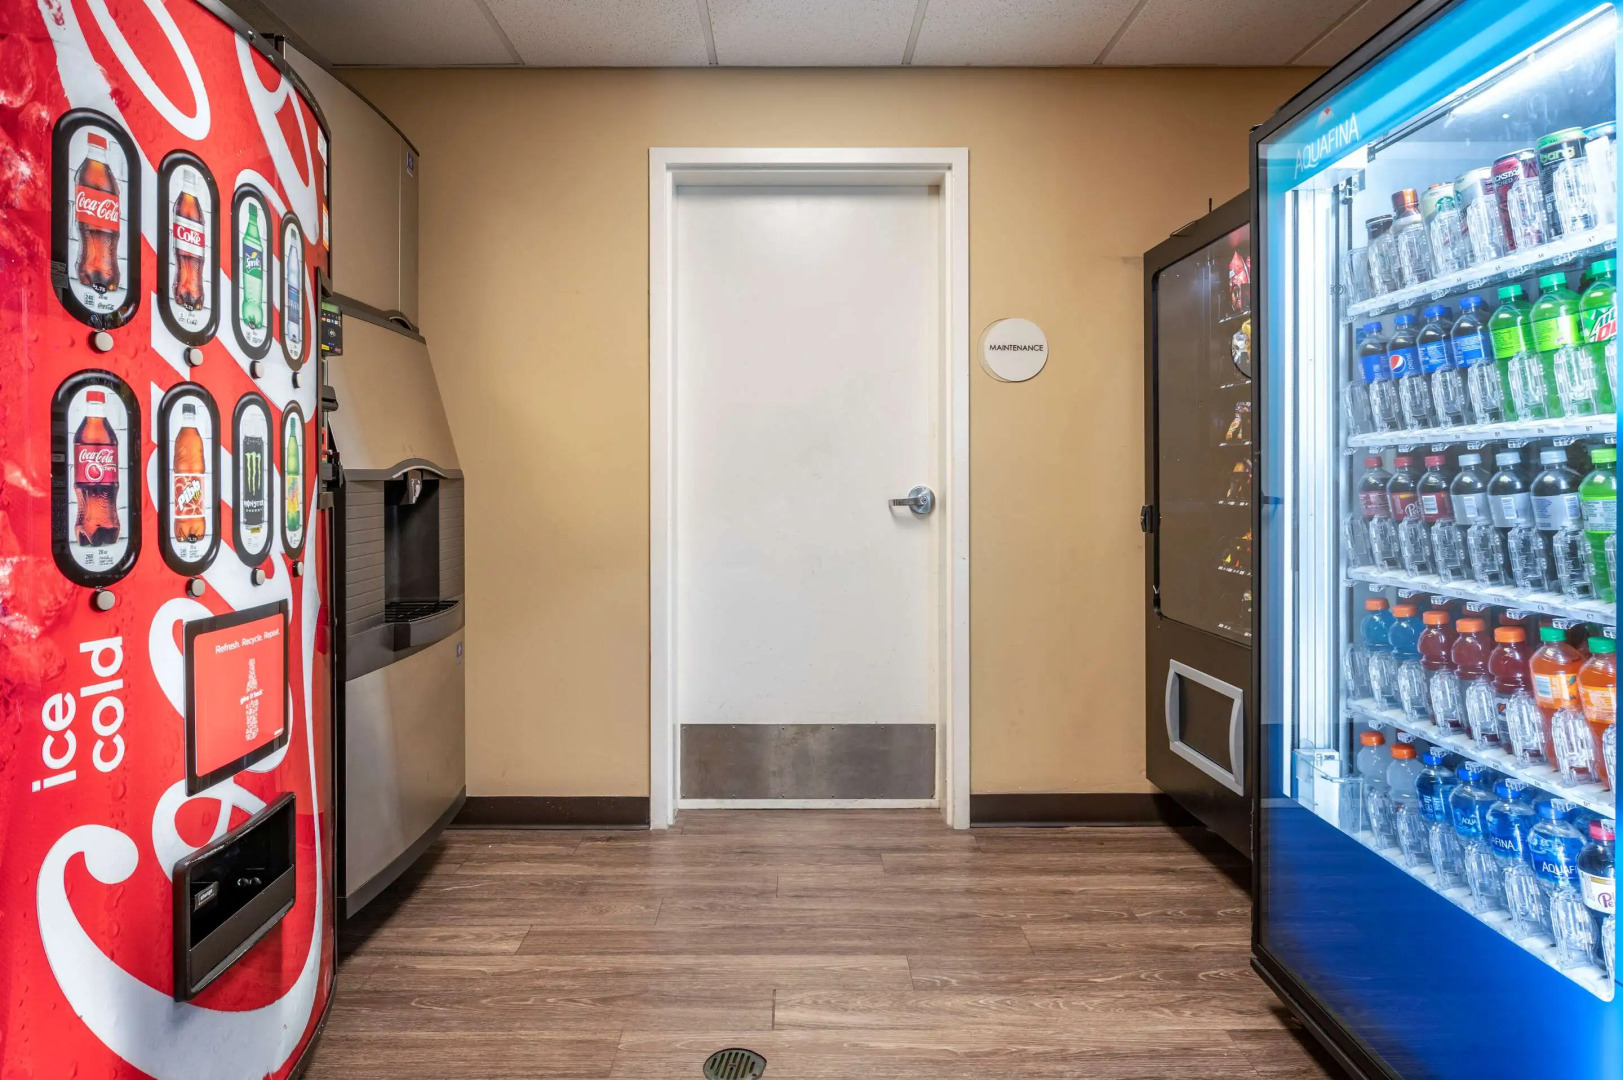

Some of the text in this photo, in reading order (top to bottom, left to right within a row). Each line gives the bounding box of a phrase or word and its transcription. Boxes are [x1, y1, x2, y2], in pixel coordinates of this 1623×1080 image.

[1294, 112, 1359, 180] AQUAFINA
[76, 191, 119, 222] Coca-Cola
[177, 226, 201, 244] Coke
[989, 344, 1044, 352] MAINTENANCE
[79, 448, 115, 463] Coca-Cola
[243, 499, 264, 508] MONSTER
[214, 640, 240, 654] Refresh.
[241, 634, 263, 646] Recycle.
[79, 636, 125, 773] cold
[32, 692, 77, 793] ice
